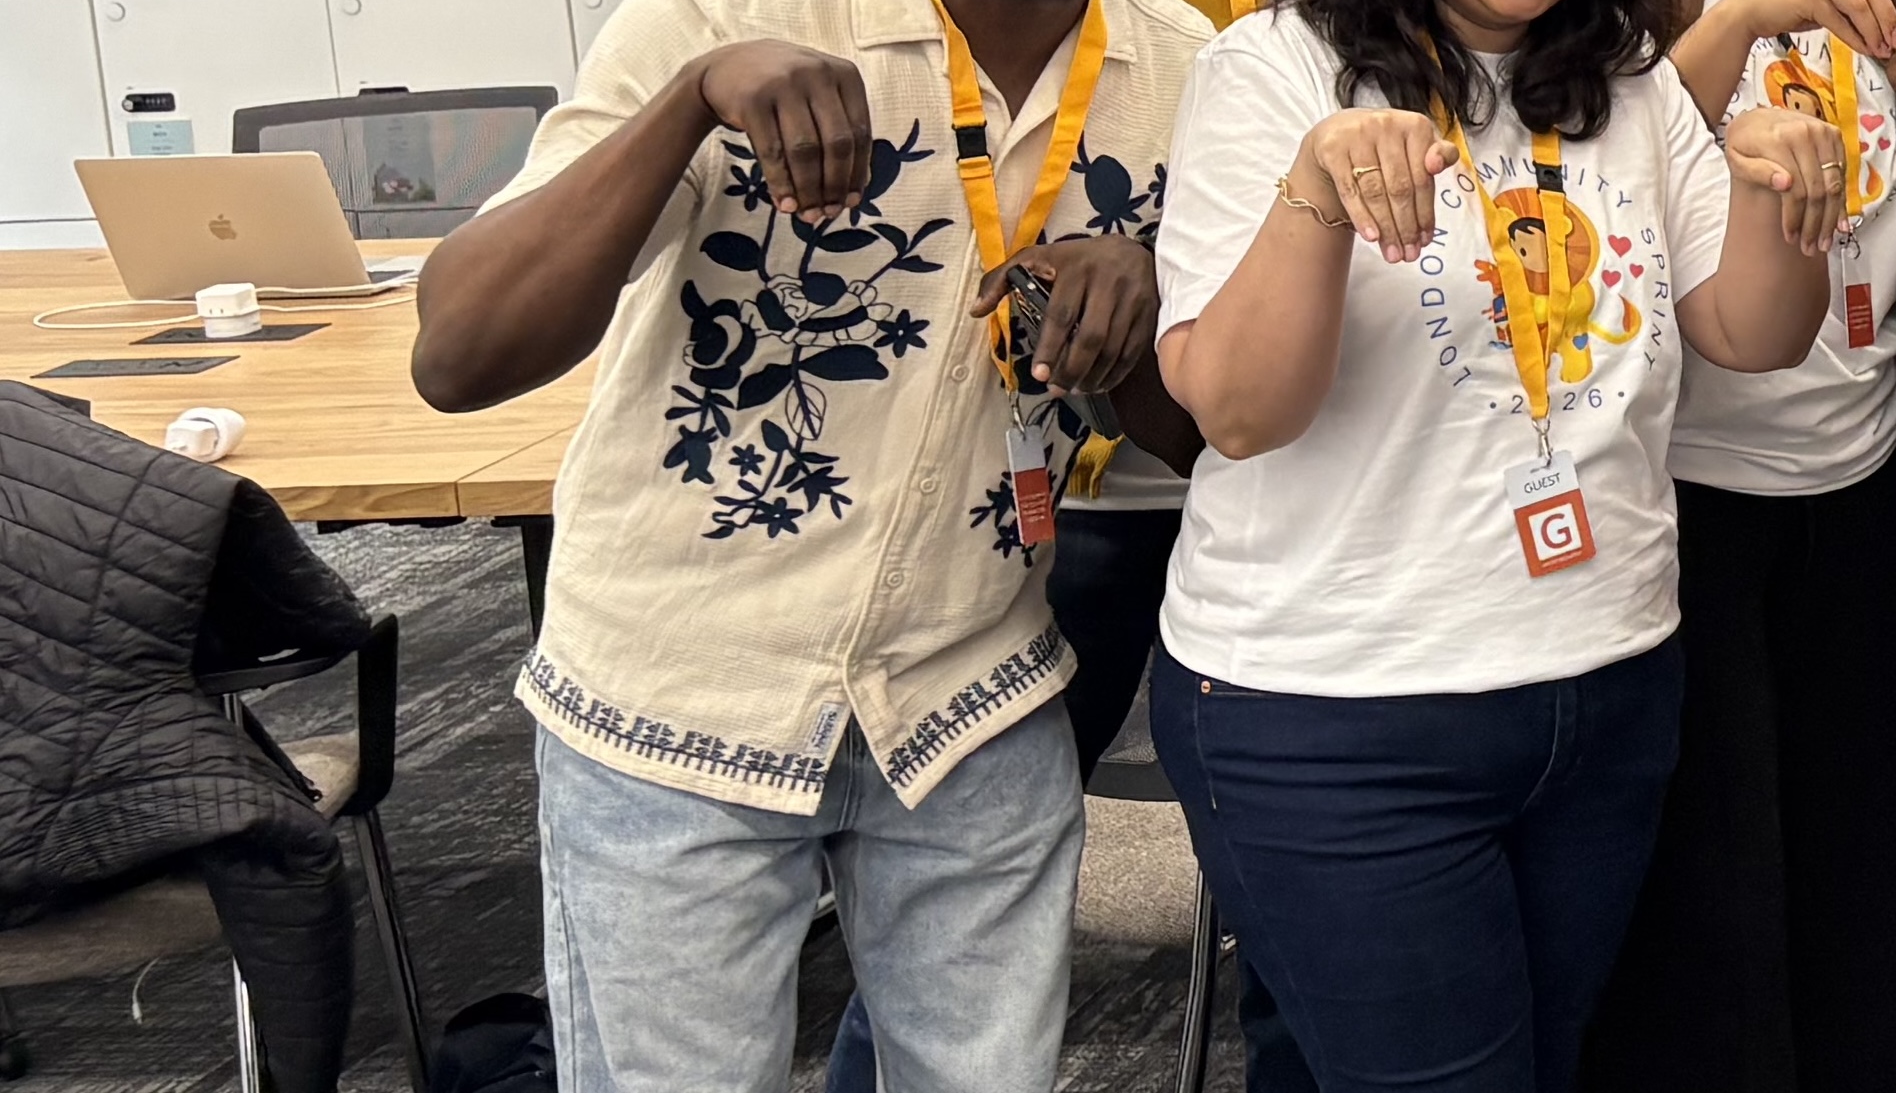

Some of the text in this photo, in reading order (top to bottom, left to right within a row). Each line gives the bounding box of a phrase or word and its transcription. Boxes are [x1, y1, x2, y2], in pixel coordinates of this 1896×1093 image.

[1420, 227, 1471, 387] LONDON
[1641, 227, 1669, 371] SPRINT
[1511, 388, 1602, 414] 226
[1524, 472, 1560, 494] GUEST
[1541, 513, 1573, 549] G
